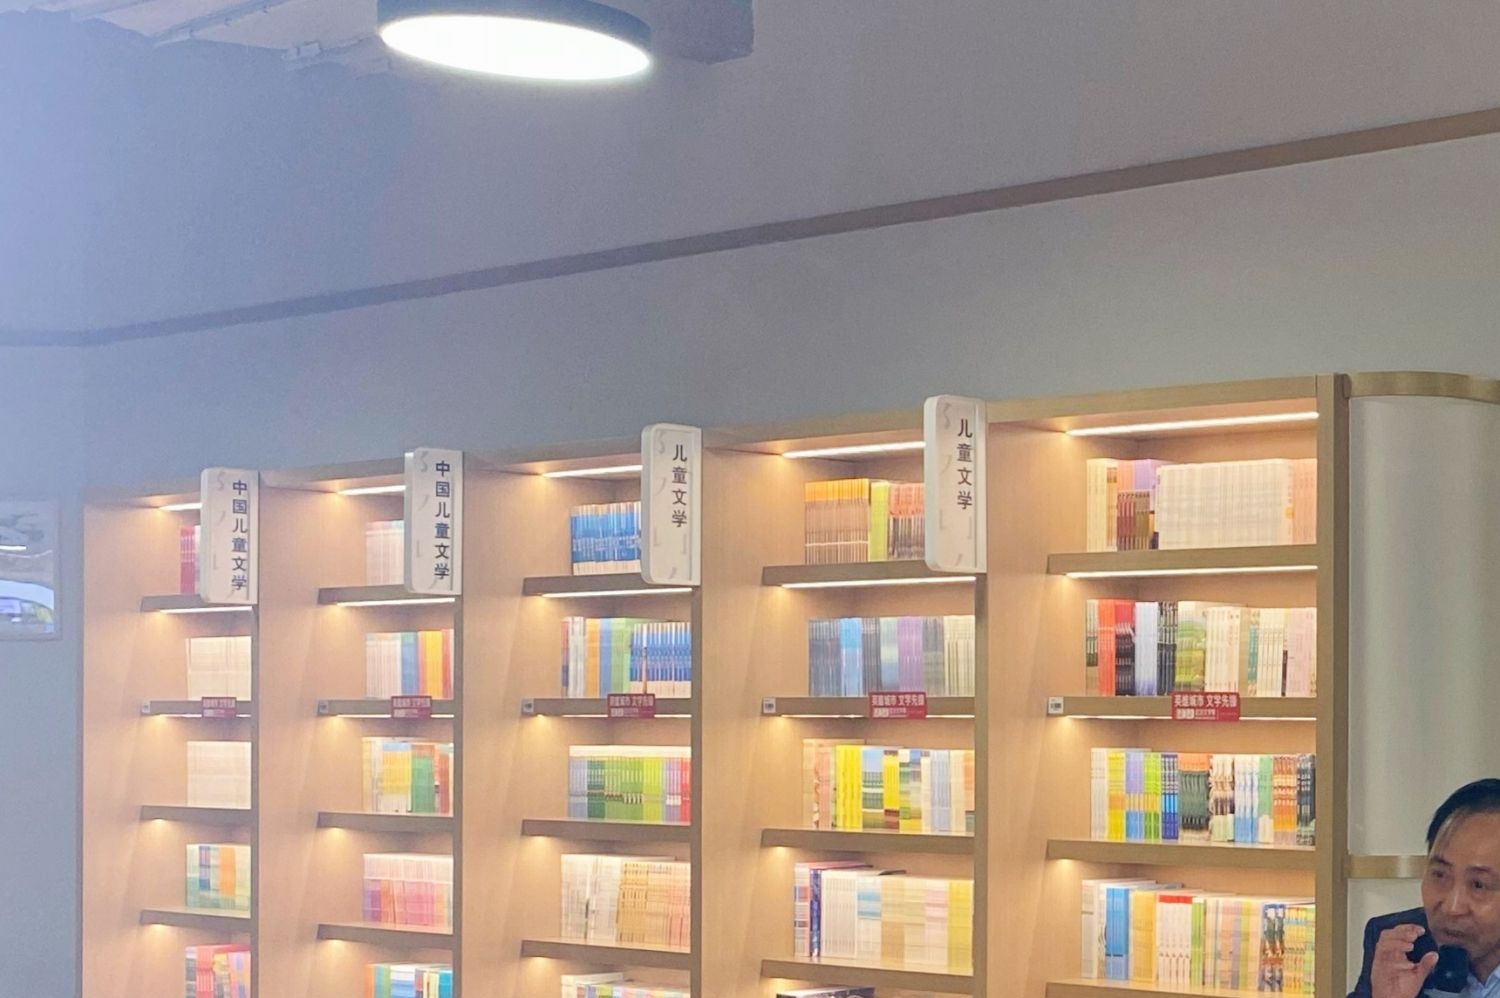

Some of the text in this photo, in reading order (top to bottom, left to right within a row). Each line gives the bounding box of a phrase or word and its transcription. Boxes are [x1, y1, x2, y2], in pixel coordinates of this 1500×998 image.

[672, 444, 688, 528] 儿童文学
[957, 418, 973, 510] 儿童文学
[231, 479, 248, 591] 中国儿童文学
[434, 460, 451, 580] 中国儿童文学
